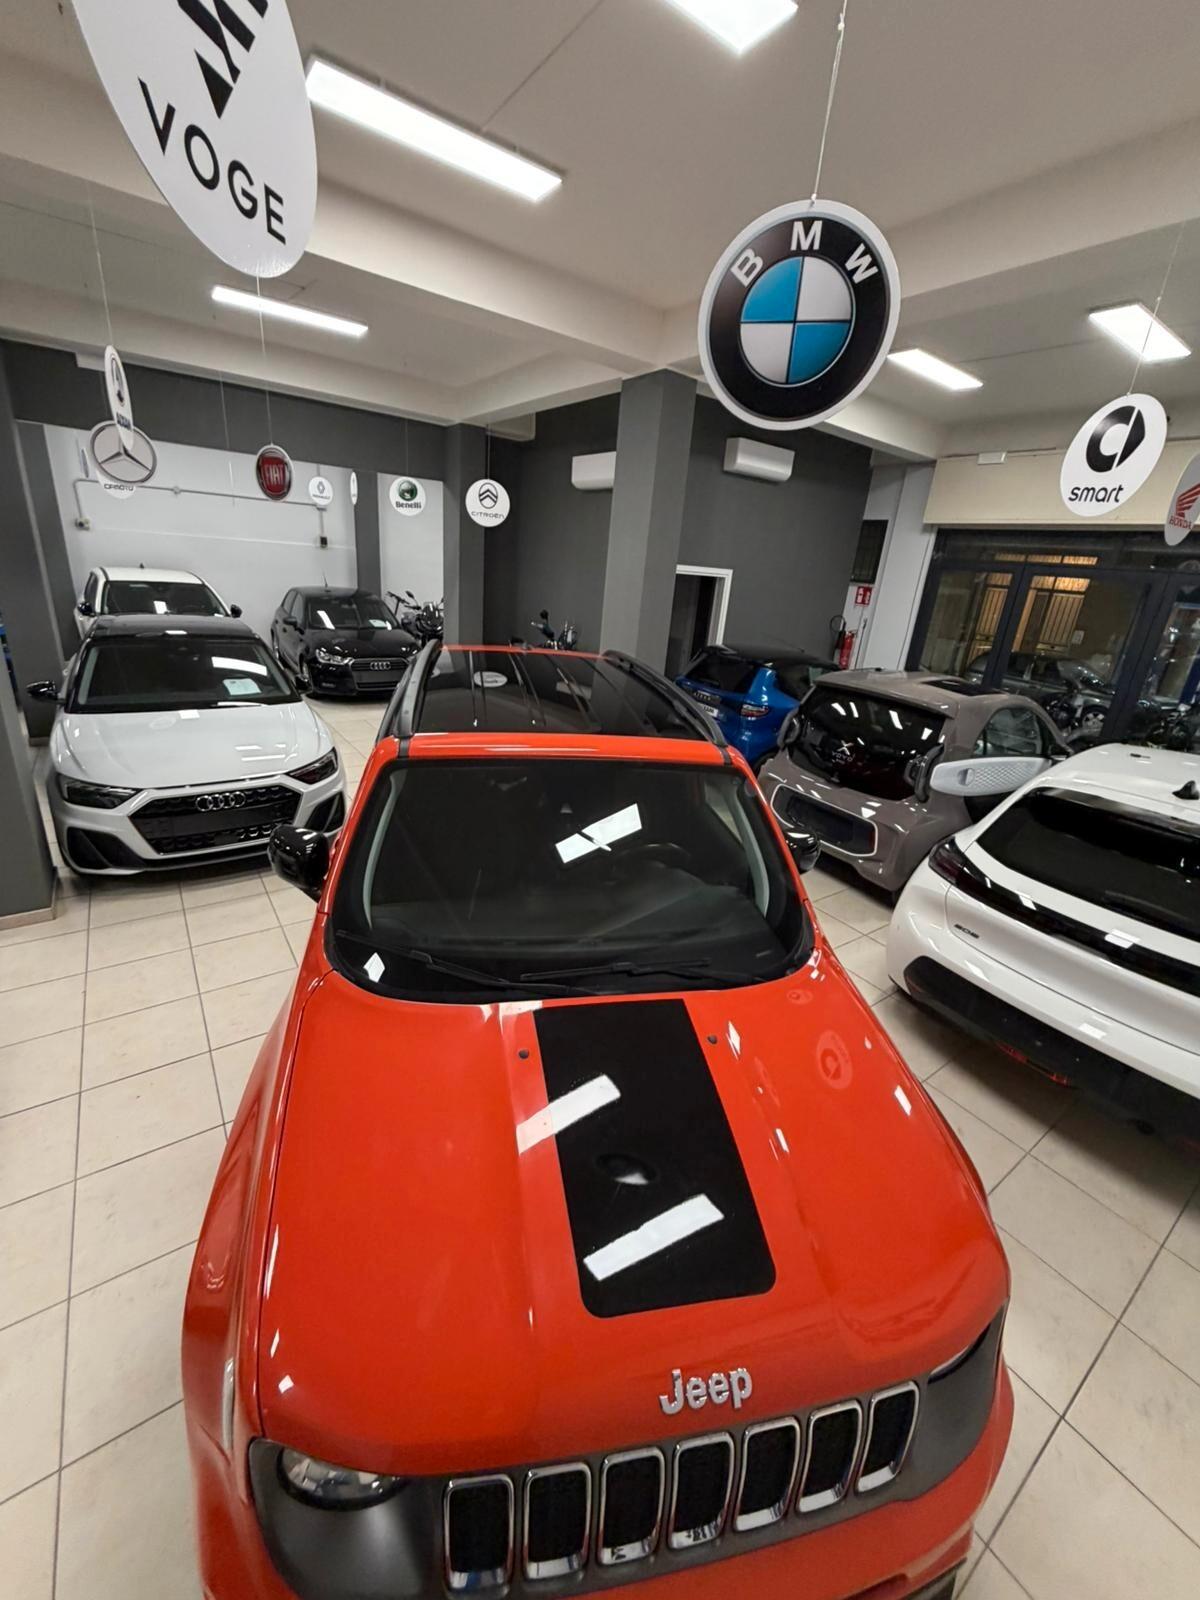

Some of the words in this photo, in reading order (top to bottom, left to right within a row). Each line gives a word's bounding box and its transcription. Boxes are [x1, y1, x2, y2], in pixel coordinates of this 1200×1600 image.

[138, 77, 286, 245] VOGE
[730, 219, 878, 288] BMW
[264, 463, 284, 486] FIAT
[396, 501, 422, 509] Benelli
[1069, 484, 1124, 503] smart
[659, 1367, 753, 1415] Jeep
